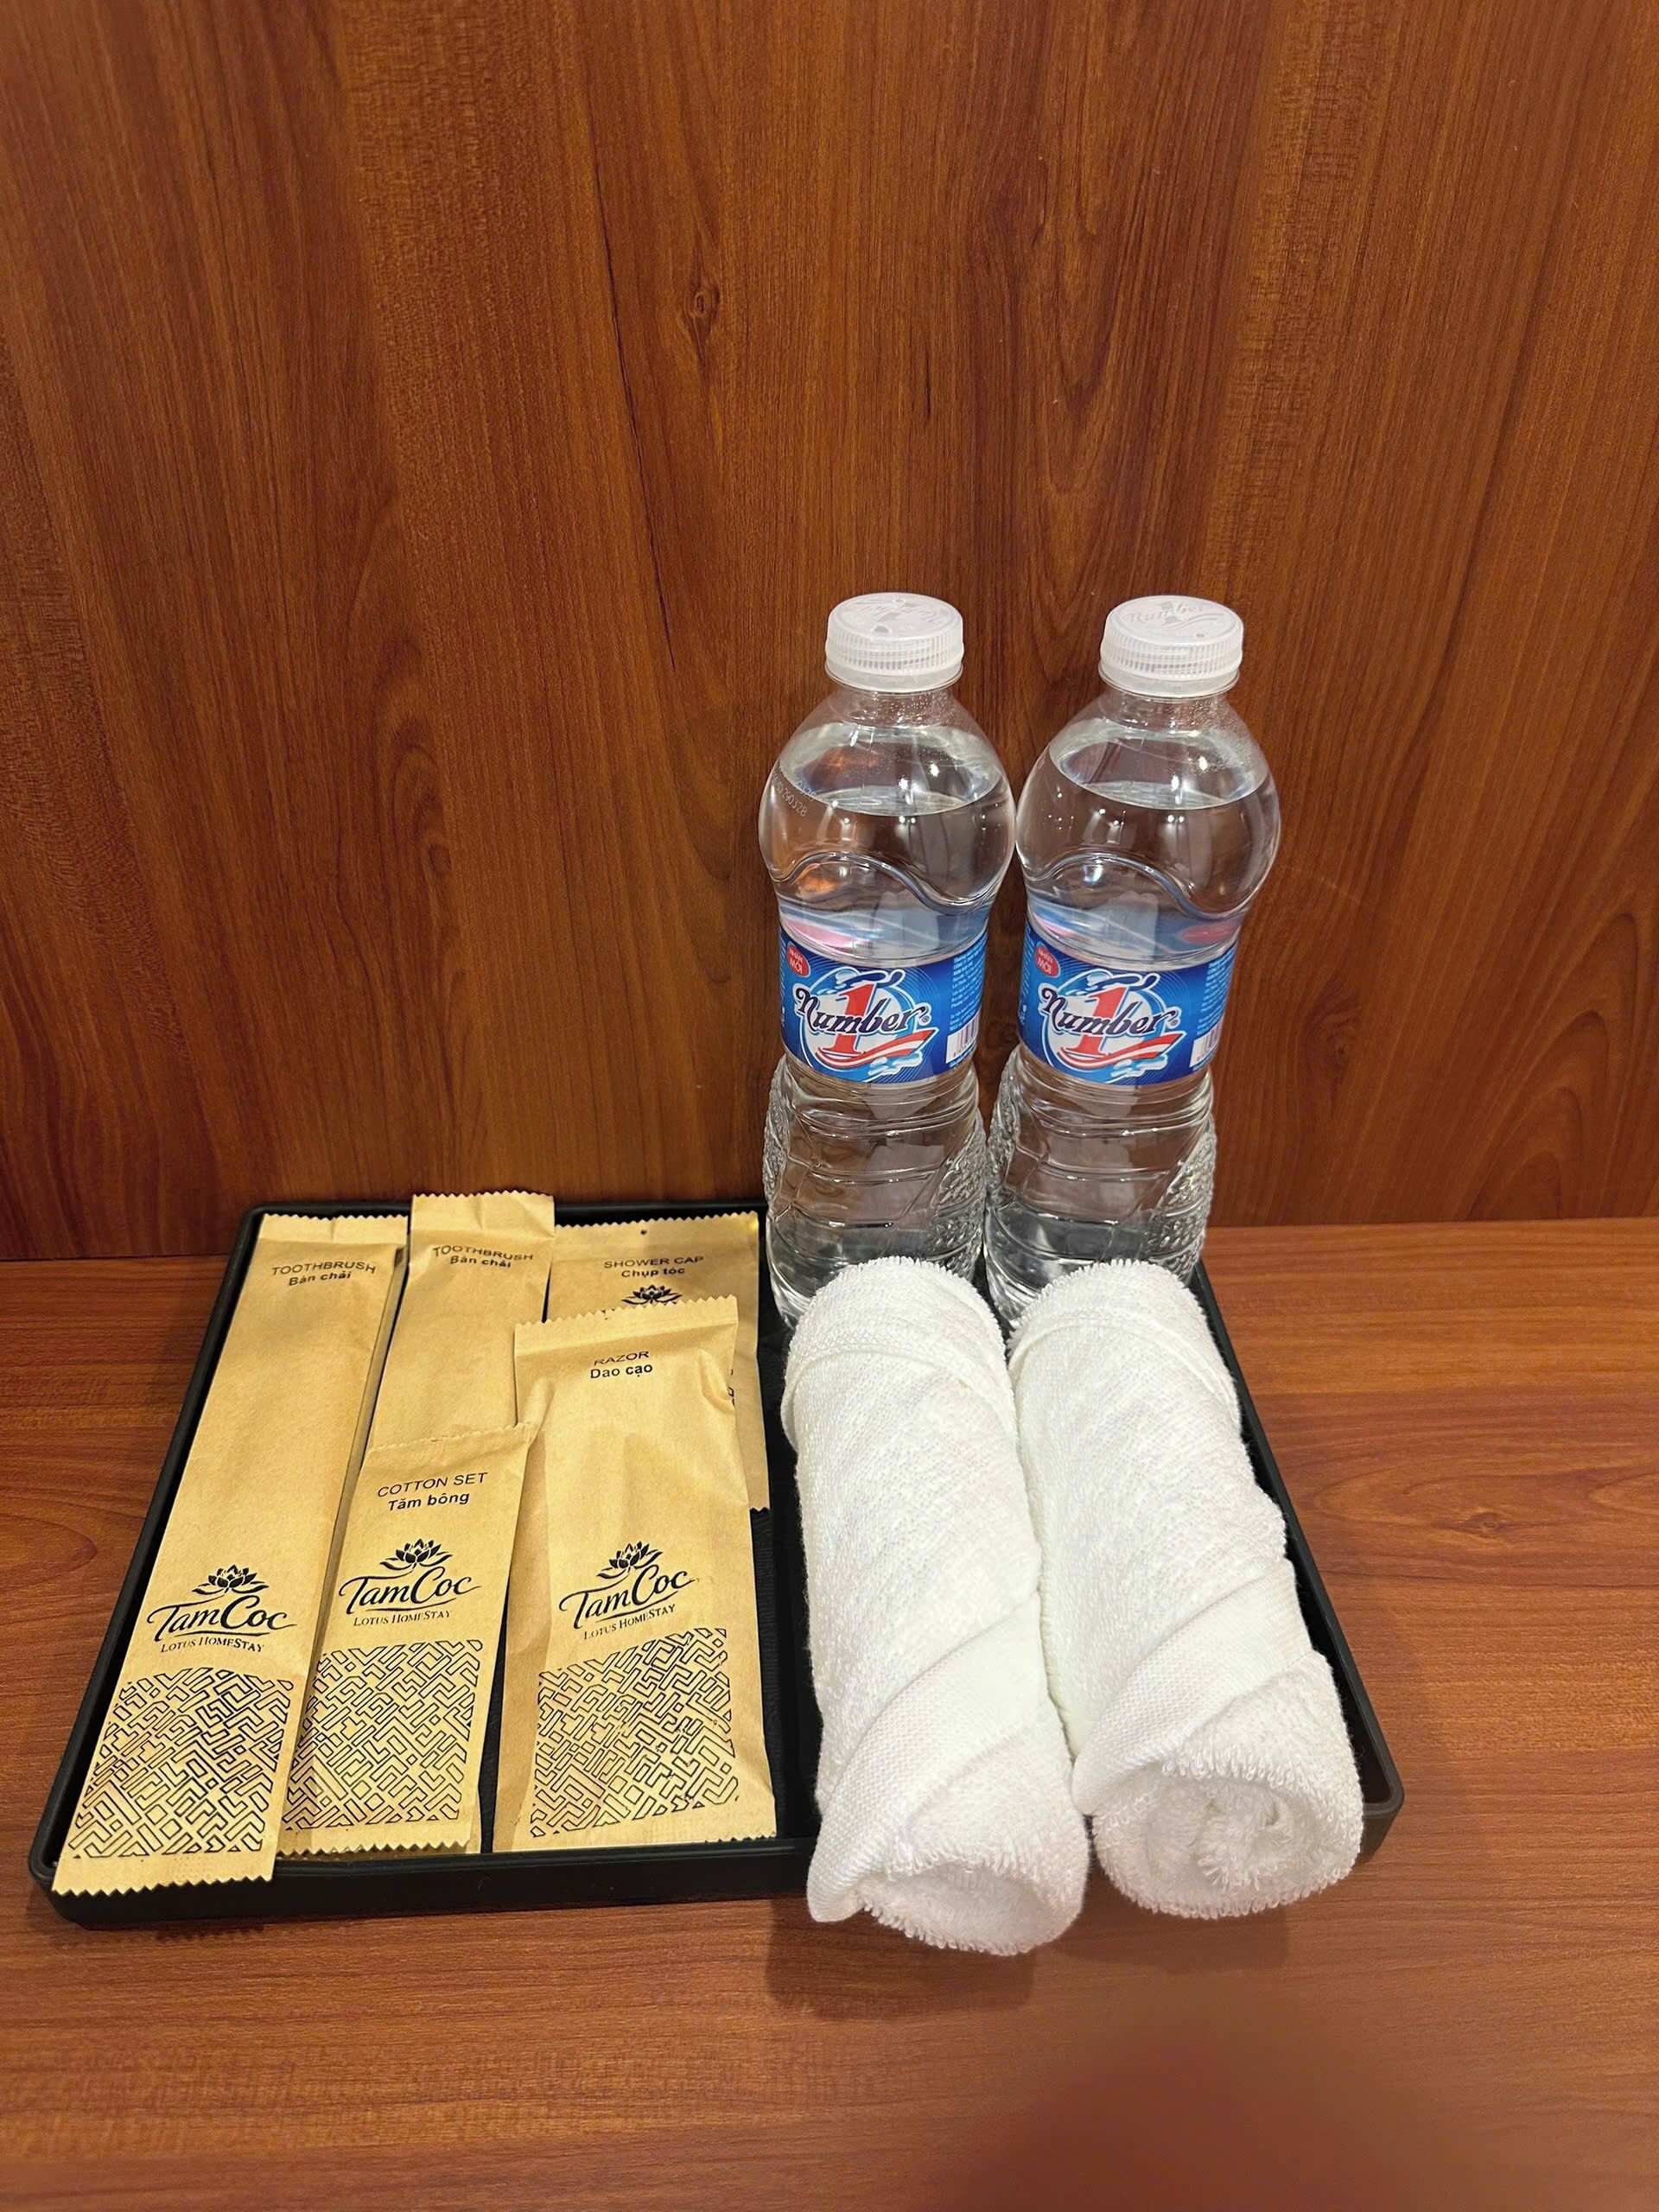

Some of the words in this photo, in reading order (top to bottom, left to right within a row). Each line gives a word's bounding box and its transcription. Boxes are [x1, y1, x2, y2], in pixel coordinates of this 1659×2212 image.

[795, 986, 929, 1034] Number
[1040, 988, 1178, 1035] Number
[821, 983, 876, 1058] 1
[1065, 986, 1129, 1058] 1
[433, 1244, 534, 1261] TOOTHBRUSH
[271, 1261, 376, 1275] TOOTHBRUSH
[603, 1257, 671, 1269] SHOWER
[674, 1255, 704, 1265] CAP
[621, 1269, 659, 1278] Chụp
[594, 1351, 650, 1366] RAZOR
[590, 1368, 620, 1379] Dao
[626, 1363, 653, 1377] cạo
[378, 1477, 448, 1497] COTTON
[453, 1471, 488, 1486] SET
[388, 1497, 422, 1511] Tăm
[427, 1492, 470, 1506] bông
